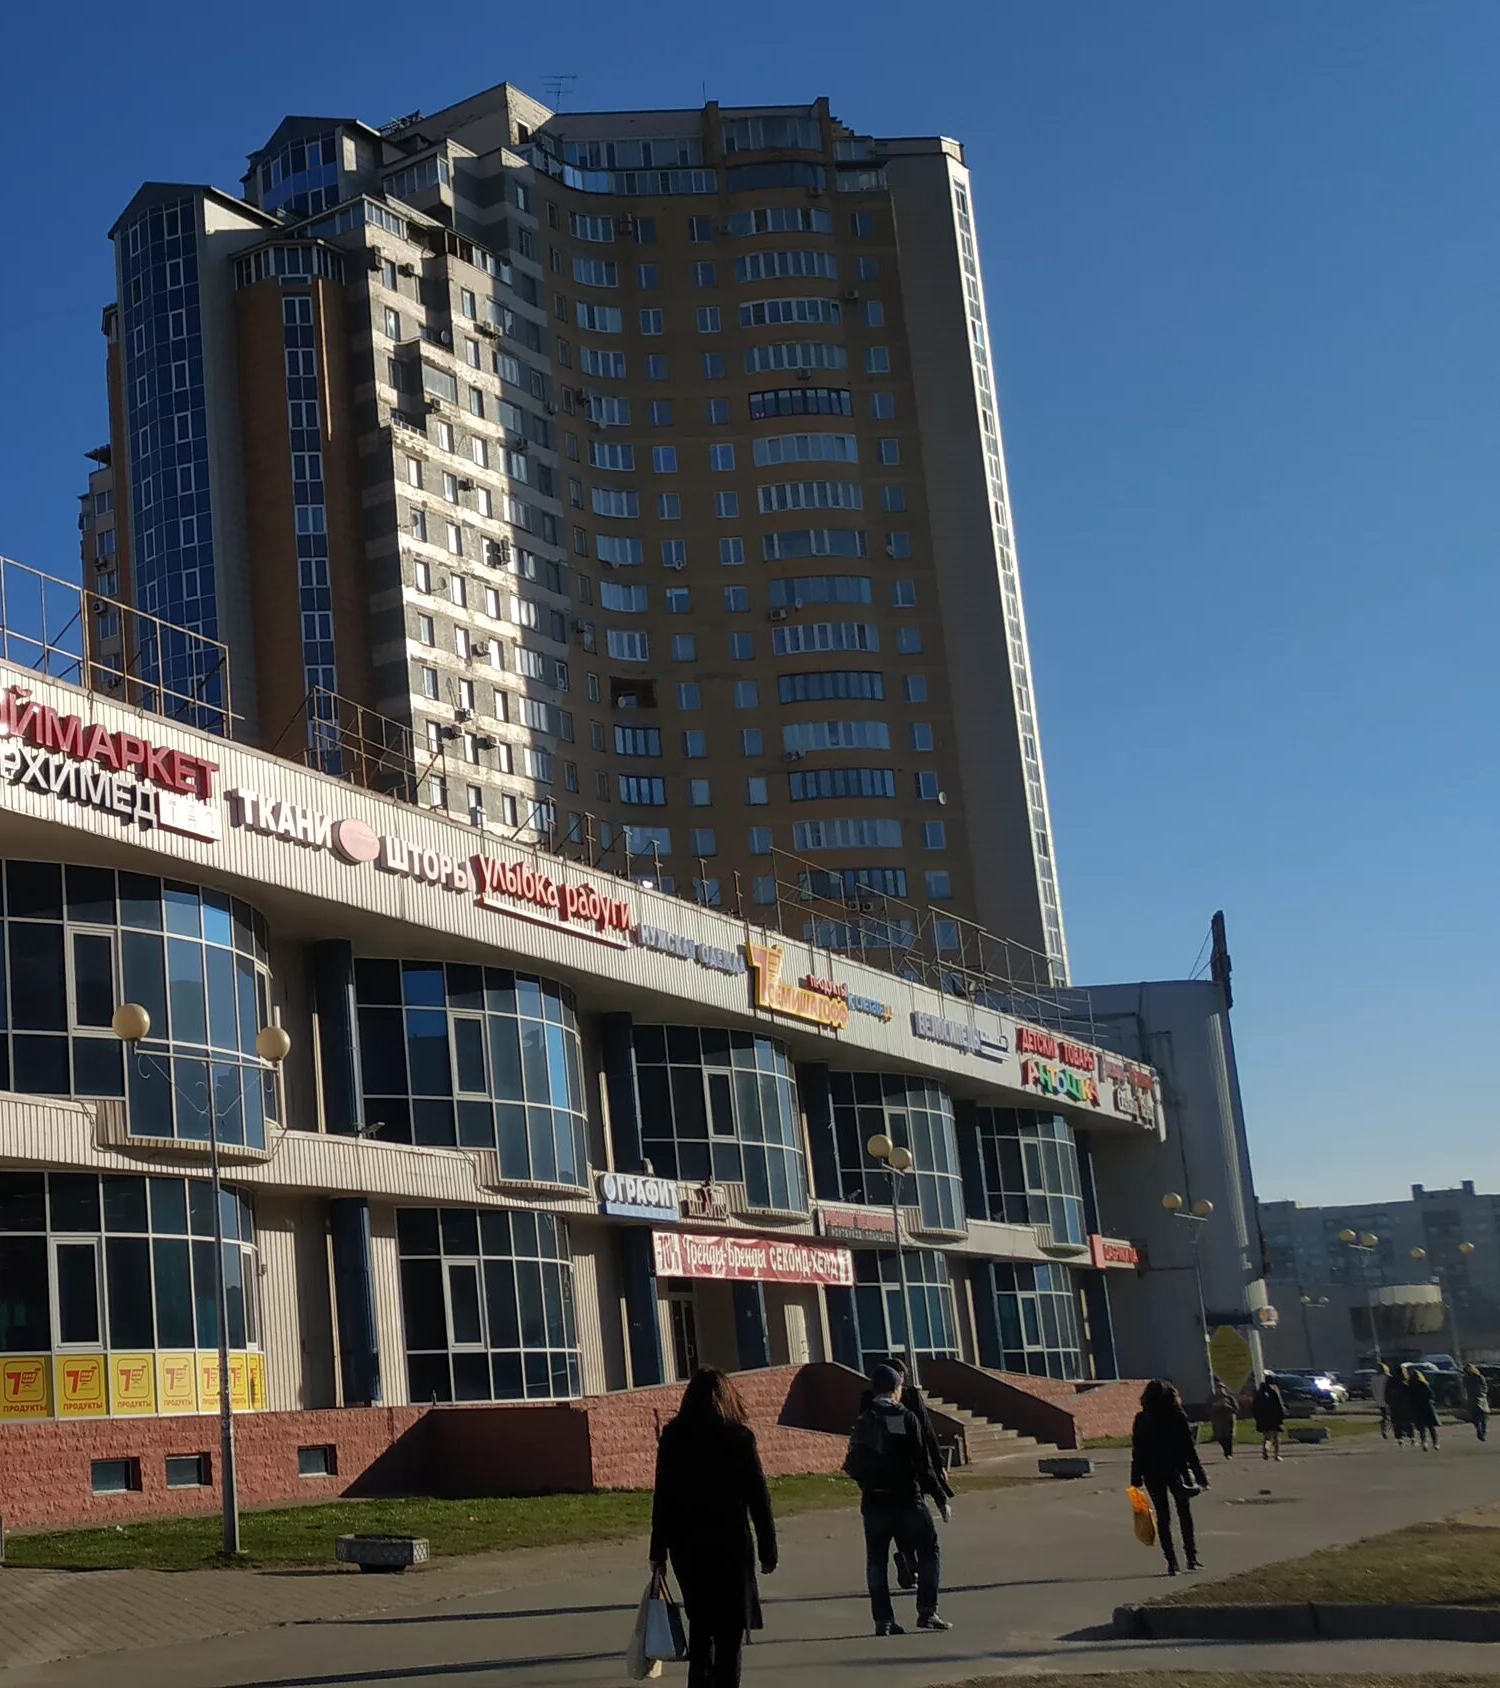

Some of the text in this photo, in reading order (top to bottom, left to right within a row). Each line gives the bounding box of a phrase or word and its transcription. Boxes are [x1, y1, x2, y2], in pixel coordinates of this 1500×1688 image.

[232, 789, 332, 849] ТКАНИ
[382, 835, 476, 892] ШТОРЫ
[565, 882, 633, 931] радуги
[1027, 1059, 1101, 1106] АНТОШКА
[614, 1173, 679, 1210] ГРАФИТ
[770, 1247, 839, 1279] СЕКОНД-ХЕНД
[63, 1401, 103, 1411] ПРОДУКТЫ
[117, 1400, 151, 1408] ПРОДУКТЫ
